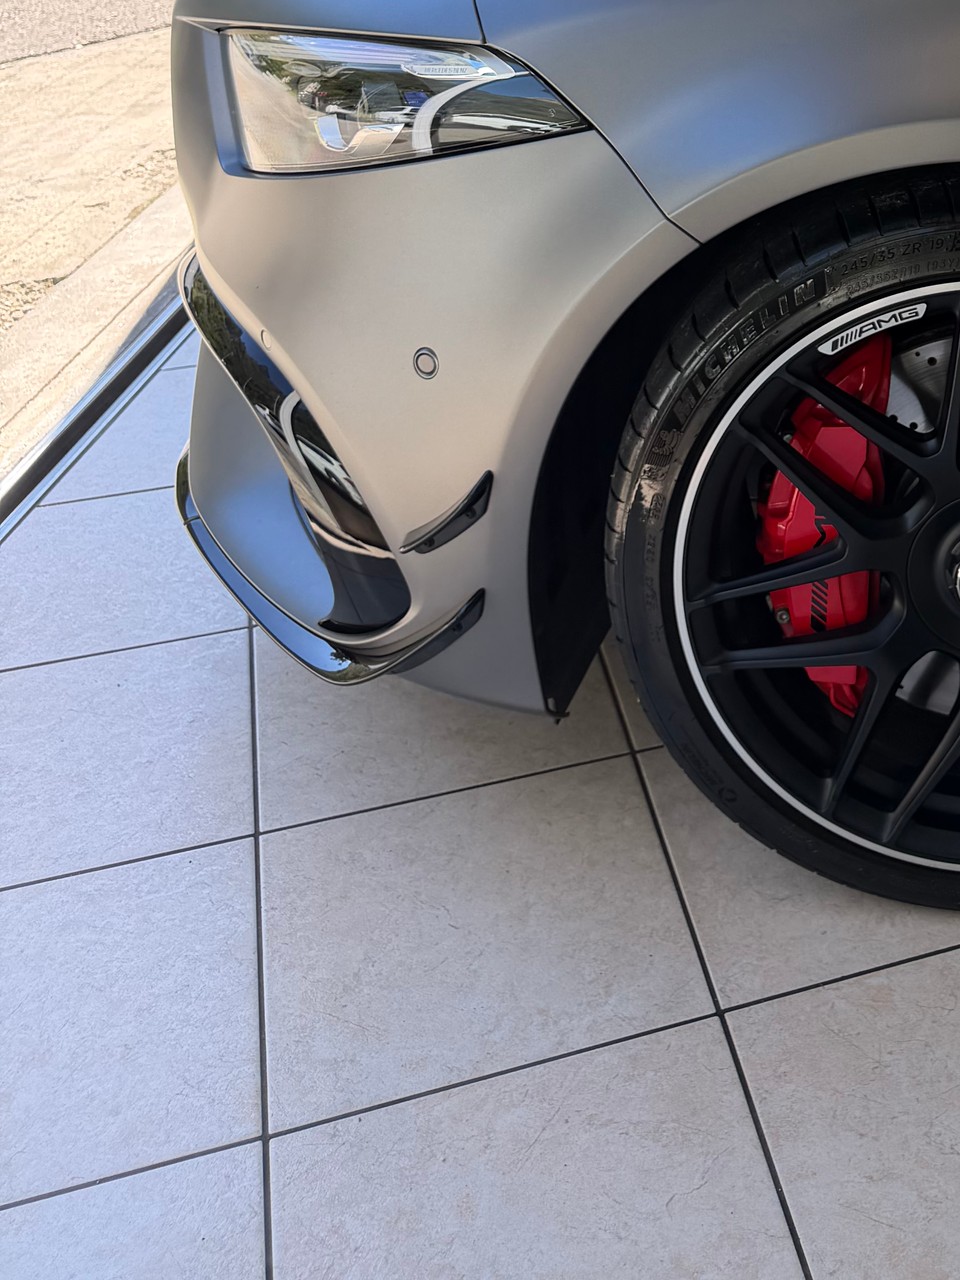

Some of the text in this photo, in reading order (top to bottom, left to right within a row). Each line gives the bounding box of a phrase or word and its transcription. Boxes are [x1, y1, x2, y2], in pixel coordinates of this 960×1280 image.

[672, 237, 945, 425] MICHELIN 245/35 ZR 19
